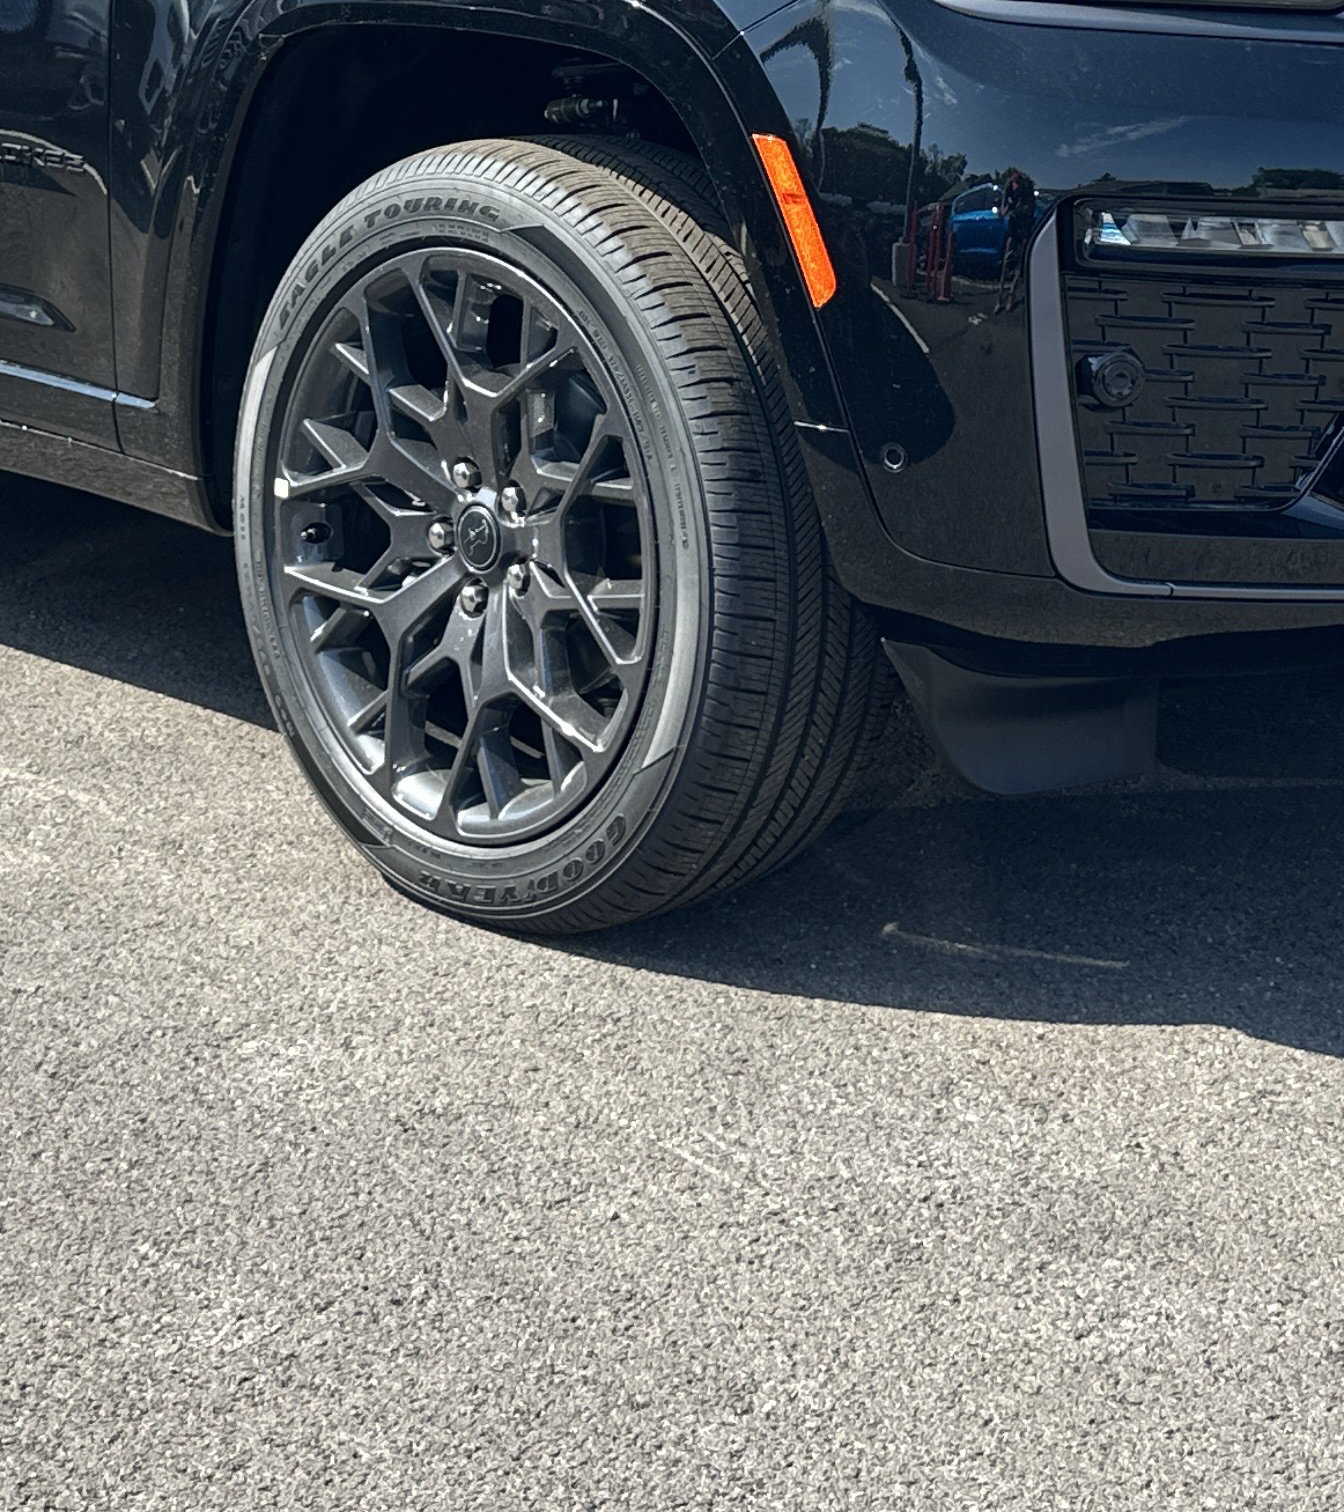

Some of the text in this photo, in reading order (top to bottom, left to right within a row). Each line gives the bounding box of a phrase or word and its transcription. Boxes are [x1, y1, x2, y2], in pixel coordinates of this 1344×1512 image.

[278, 196, 502, 330] EAGLE TOURING
[418, 813, 629, 903] GOODYEAR
